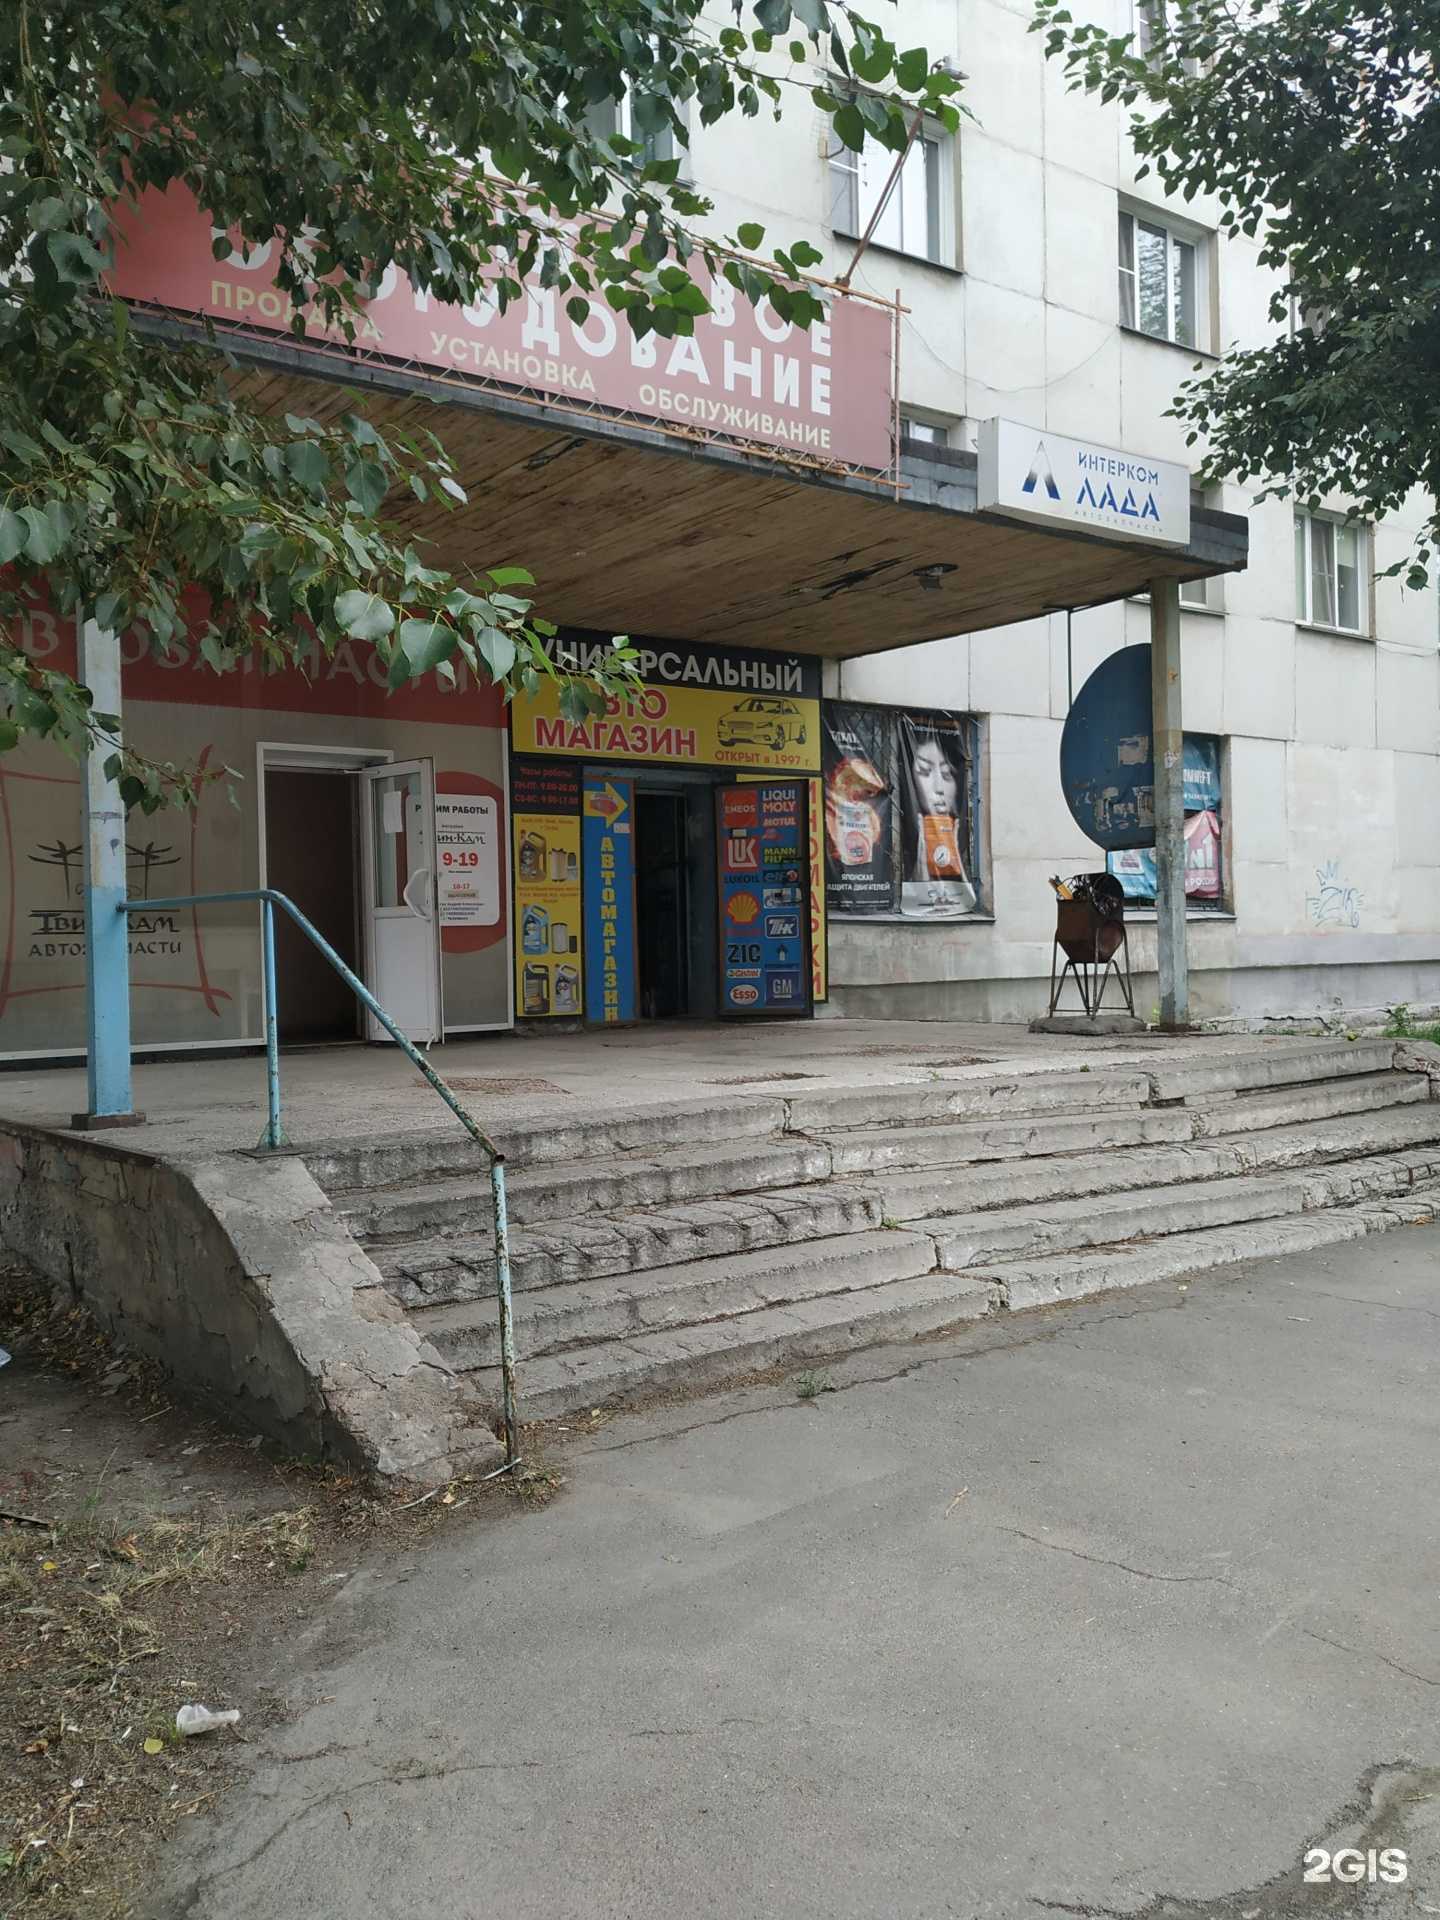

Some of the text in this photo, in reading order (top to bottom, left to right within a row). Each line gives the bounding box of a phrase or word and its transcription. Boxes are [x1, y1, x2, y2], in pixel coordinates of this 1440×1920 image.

[431, 331, 596, 393] УСТАНОВКА
[639, 383, 832, 449] ОБСЛУЖИВАНИЕ
[1078, 451, 1159, 486] ИНТЕРКОМ
[1076, 477, 1161, 522] ЛАДА
[535, 717, 697, 757] МАГАЗИН
[715, 750, 760, 764] ОТКРЫТ
[774, 754, 801, 765] 1997
[762, 789, 797, 802] LIQUI
[452, 805, 489, 815] РАБОТЫ
[762, 801, 797, 813] MOLY
[442, 851, 479, 867] 9-19
[600, 836, 619, 1022] АВТОМАГАЗИН
[727, 943, 761, 963] ZIC
[772, 978, 793, 994] GM
